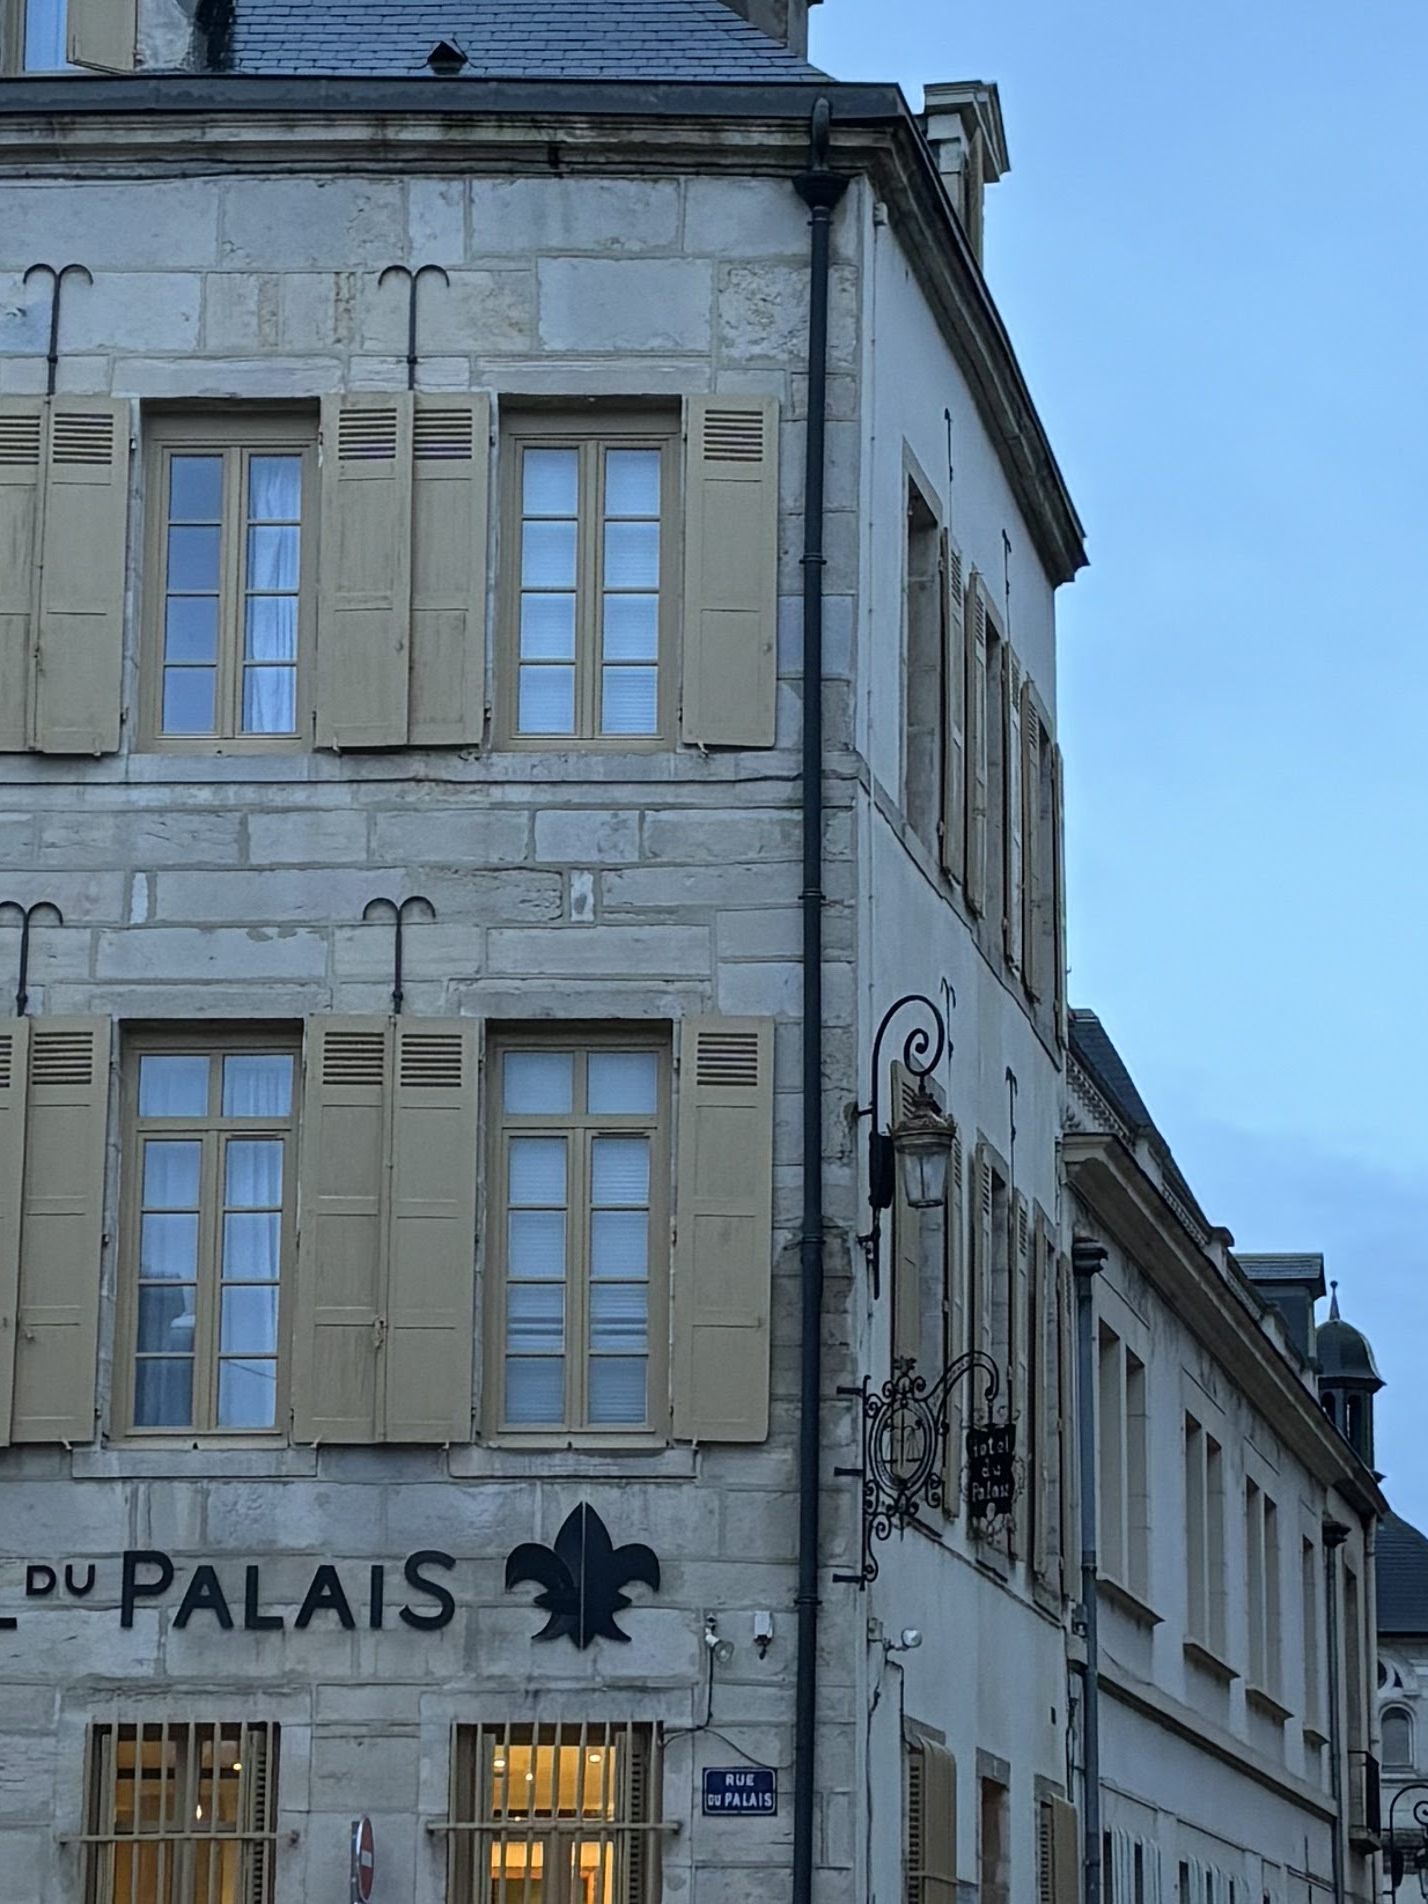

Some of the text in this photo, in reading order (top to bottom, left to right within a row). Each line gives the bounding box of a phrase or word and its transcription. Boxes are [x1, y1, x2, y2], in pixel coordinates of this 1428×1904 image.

[25, 1564, 95, 1596] DU
[121, 1550, 457, 1631] PALAIS
[725, 1773, 755, 1786] RUE
[707, 1792, 773, 1807] DU PALAIS
